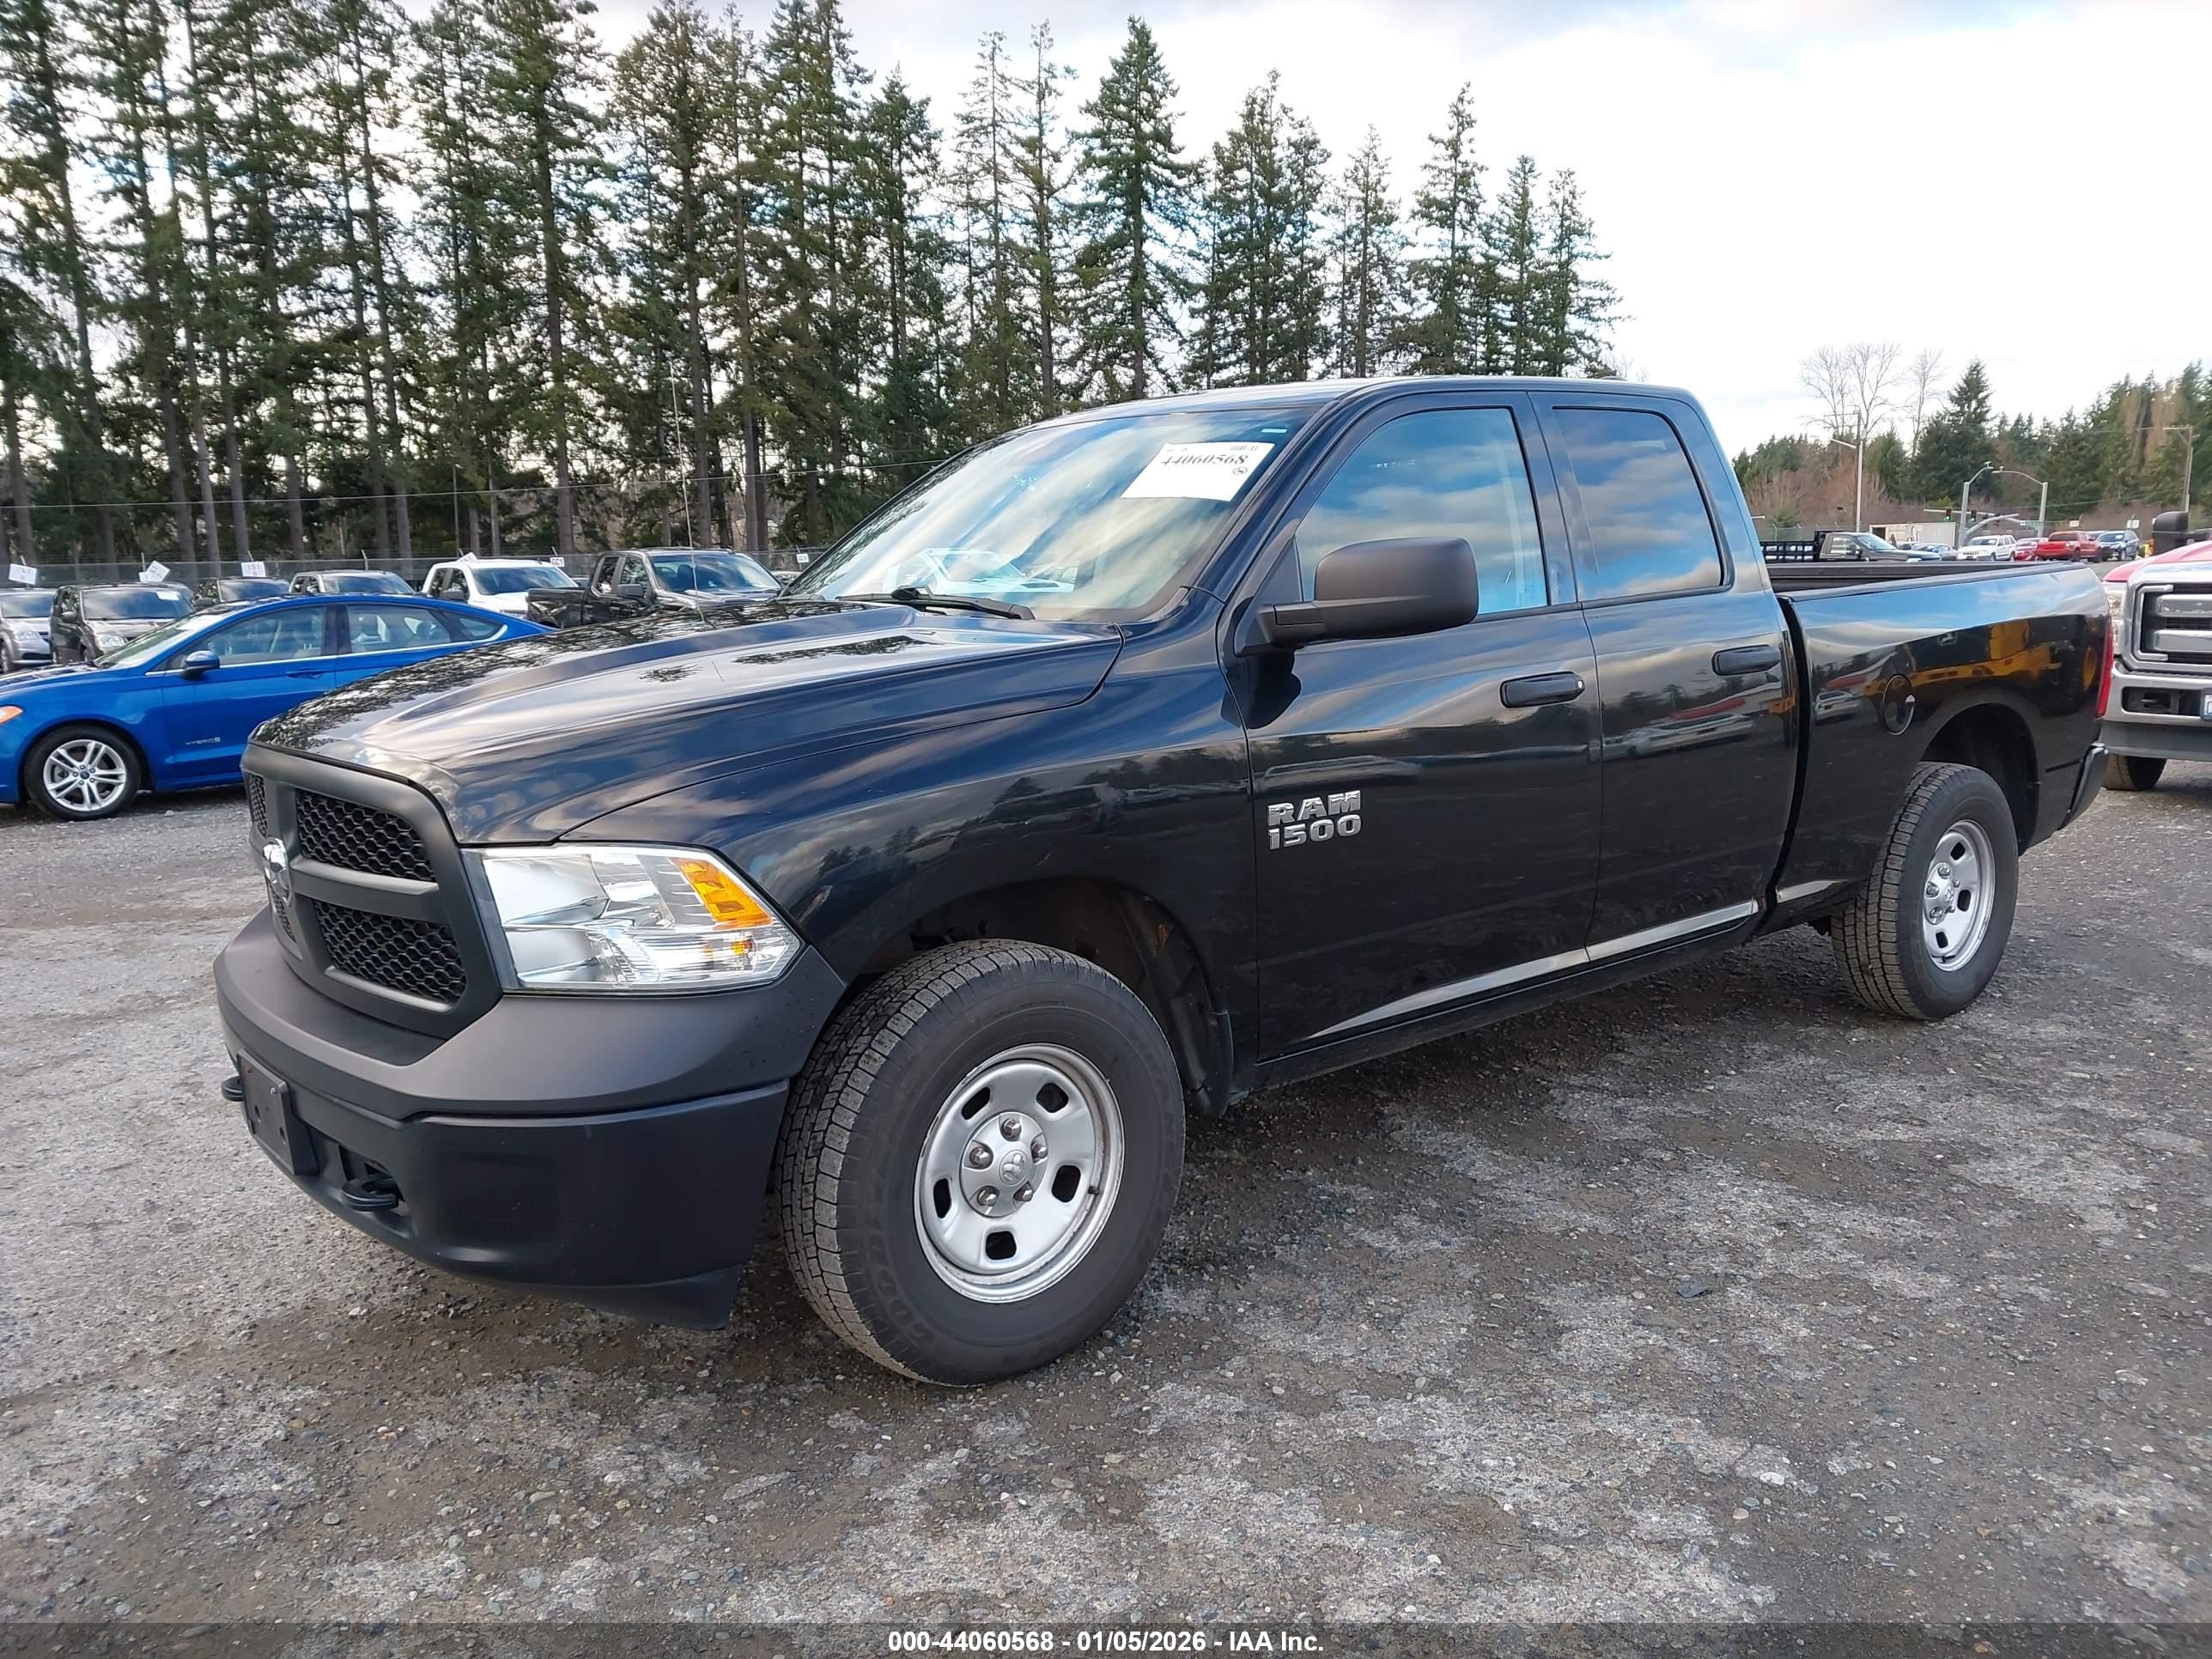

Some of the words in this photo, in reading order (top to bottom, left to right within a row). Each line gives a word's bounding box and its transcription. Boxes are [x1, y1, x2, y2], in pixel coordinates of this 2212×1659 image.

[1161, 454, 1249, 465] 44060568
[1267, 790, 1361, 826] RAM
[1267, 814, 1362, 850] 1500
